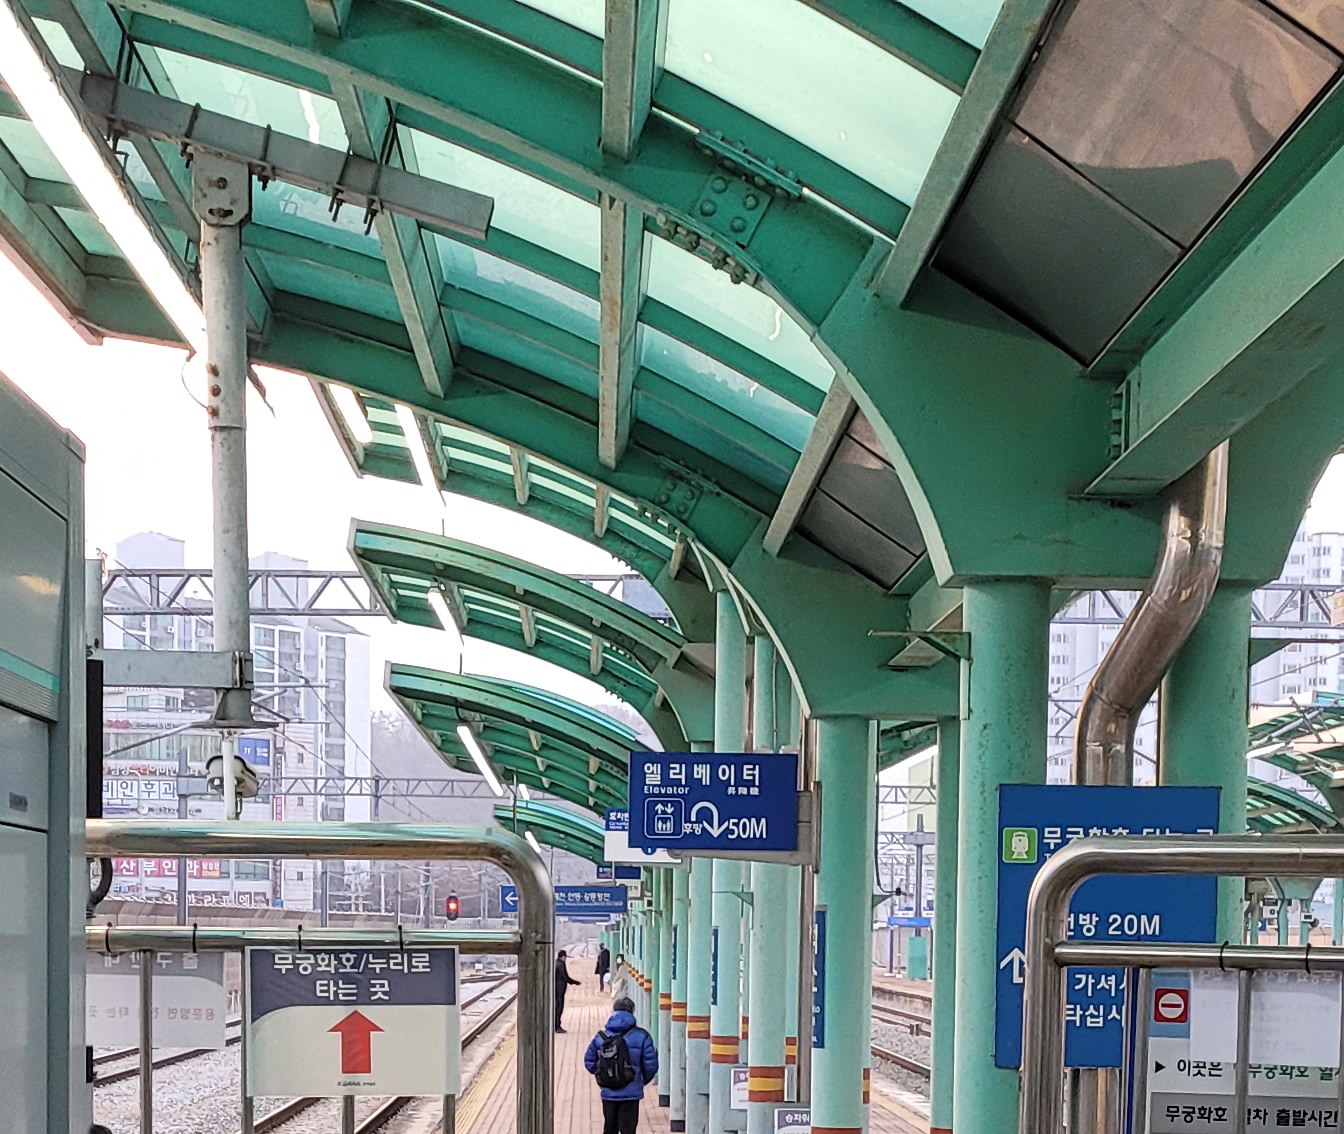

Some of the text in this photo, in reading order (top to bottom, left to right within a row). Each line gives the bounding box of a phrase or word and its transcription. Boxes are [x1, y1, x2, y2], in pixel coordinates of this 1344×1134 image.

[644, 763, 759, 786] 엘리베이터
[103, 780, 177, 798] 비인후과
[644, 786, 690, 795] Elevator
[728, 818, 767, 839] 50M
[120, 860, 200, 876] 산부인과
[1108, 914, 1160, 936] 20M
[273, 952, 431, 975] 무궁화호/누리로
[315, 979, 390, 1001] 타는 곳
[1066, 1004, 1124, 1028] 타십시
[1165, 1105, 1228, 1124] 무궁화호
[1275, 1108, 1338, 1128] 출발시간
